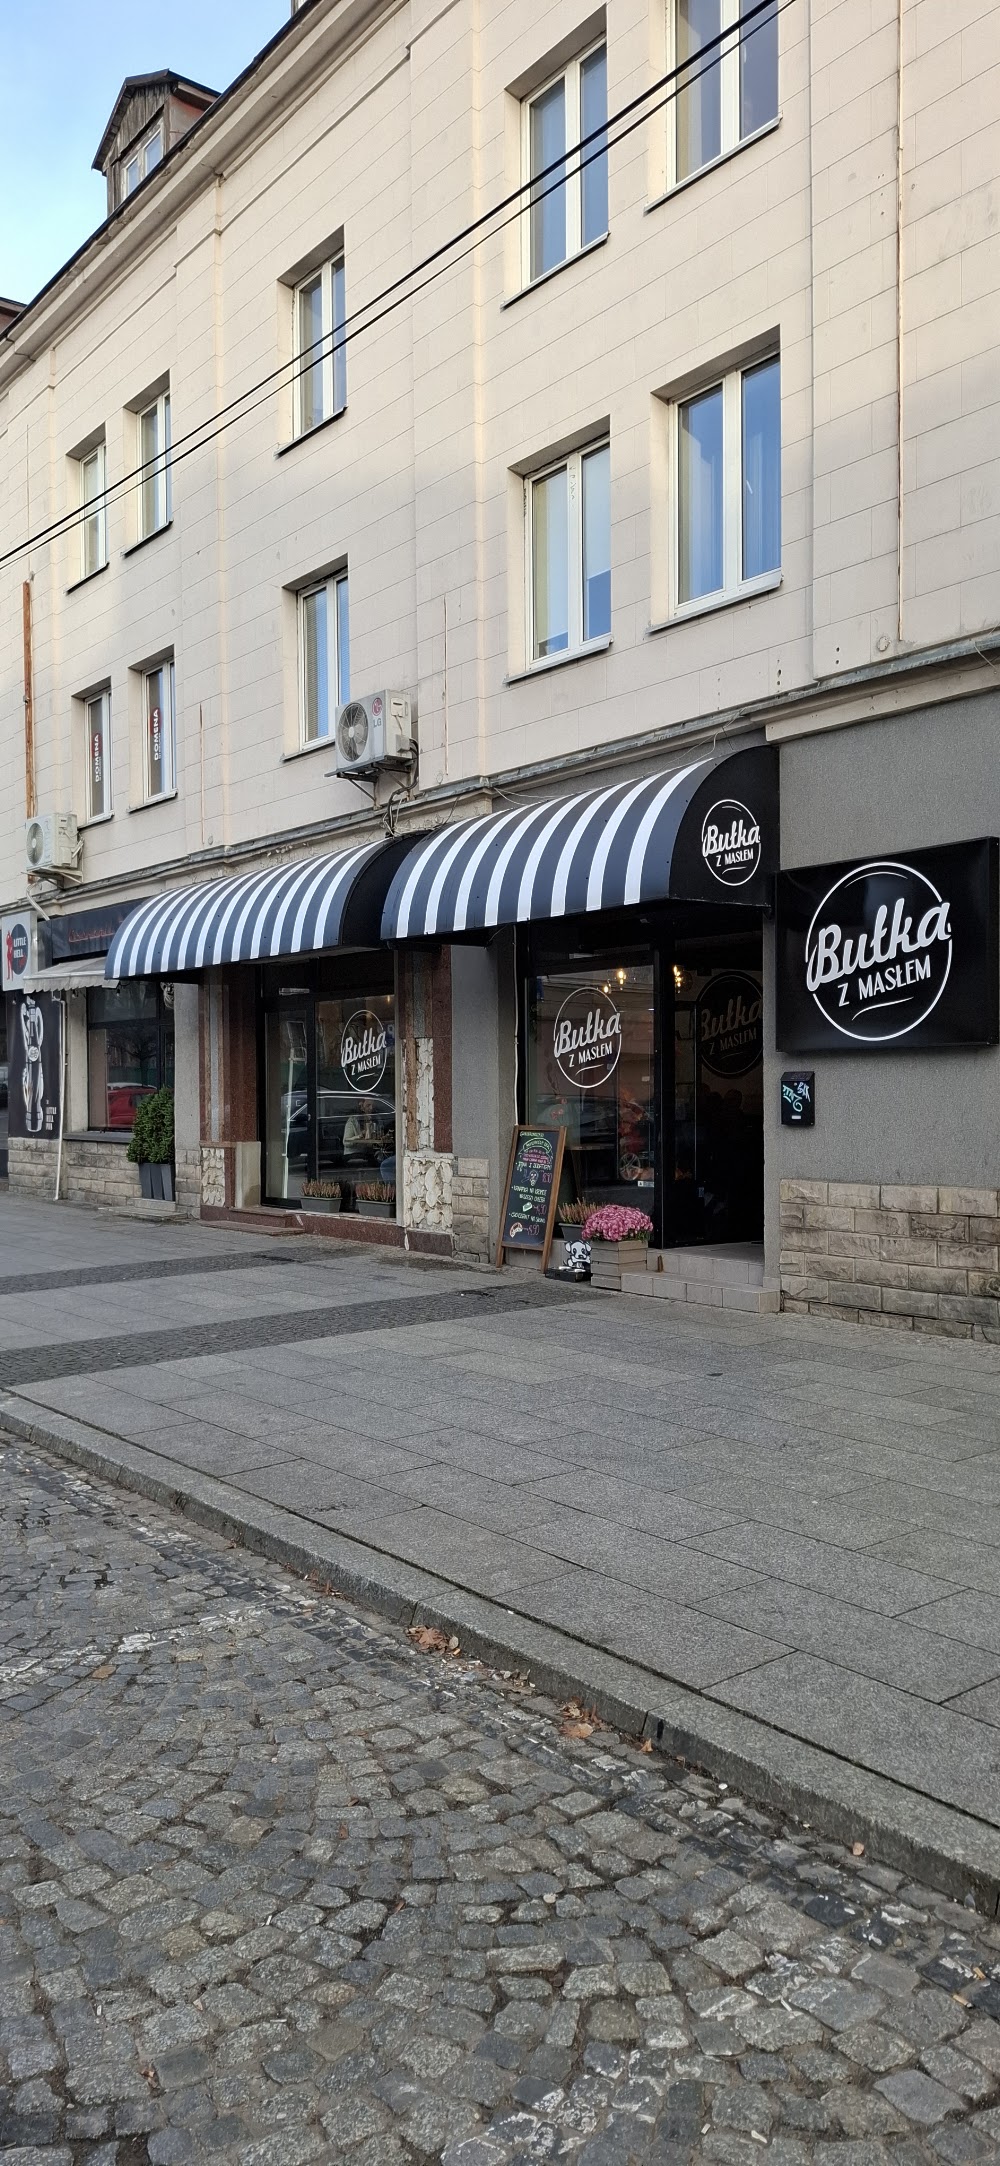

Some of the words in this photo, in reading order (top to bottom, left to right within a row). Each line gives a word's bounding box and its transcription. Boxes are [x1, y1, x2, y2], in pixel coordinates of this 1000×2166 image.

[372, 718, 382, 728] LG
[702, 819, 760, 858] Bułka
[716, 854, 722, 867] Z
[13, 936, 27, 948] LITTLE
[806, 898, 952, 992] Bułka
[13, 948, 24, 959] HELL
[837, 982, 850, 1007] Z
[858, 954, 931, 1001] MASŁEM
[553, 1008, 621, 1058] Bułka
[341, 1027, 387, 1068] Bułka
[568, 1053, 575, 1068] Z
[351, 1064, 356, 1076] Z
